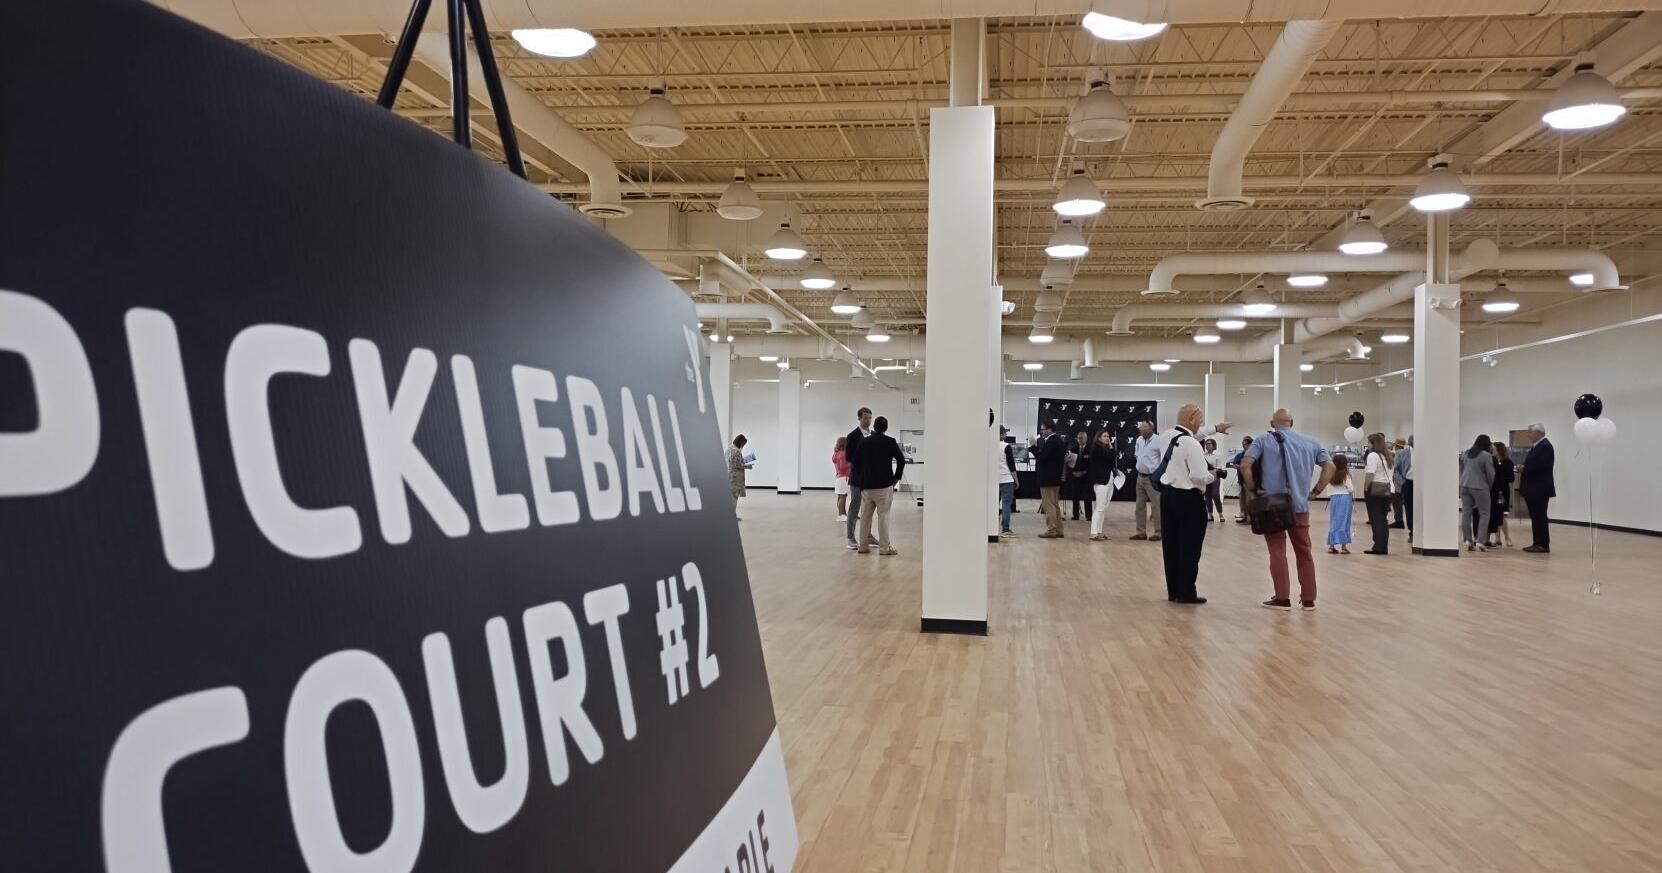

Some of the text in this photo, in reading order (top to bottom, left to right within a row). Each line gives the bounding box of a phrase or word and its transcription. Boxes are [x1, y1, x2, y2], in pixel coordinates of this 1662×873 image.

[0, 290, 703, 571] PICKLEBALL
[102, 561, 720, 873] COURT #2
